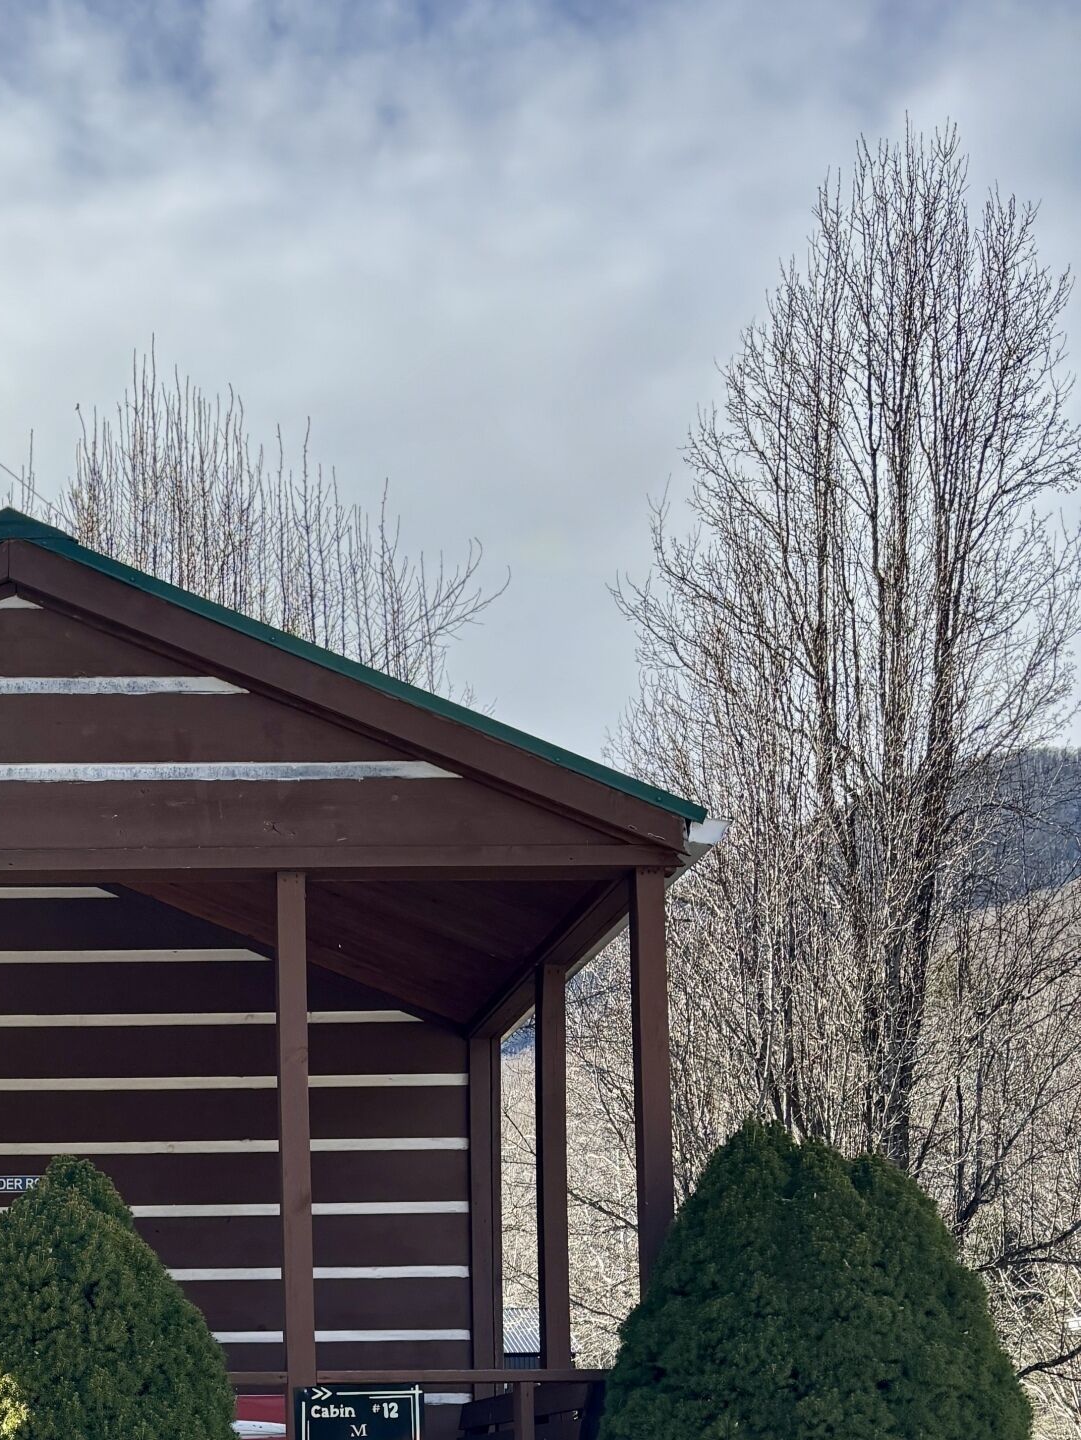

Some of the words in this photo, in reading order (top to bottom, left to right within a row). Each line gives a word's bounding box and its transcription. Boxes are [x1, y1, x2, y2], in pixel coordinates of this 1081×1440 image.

[310, 1404, 356, 1418] Cabin
[372, 1402, 399, 1419] #12
[350, 1423, 368, 1437] M
